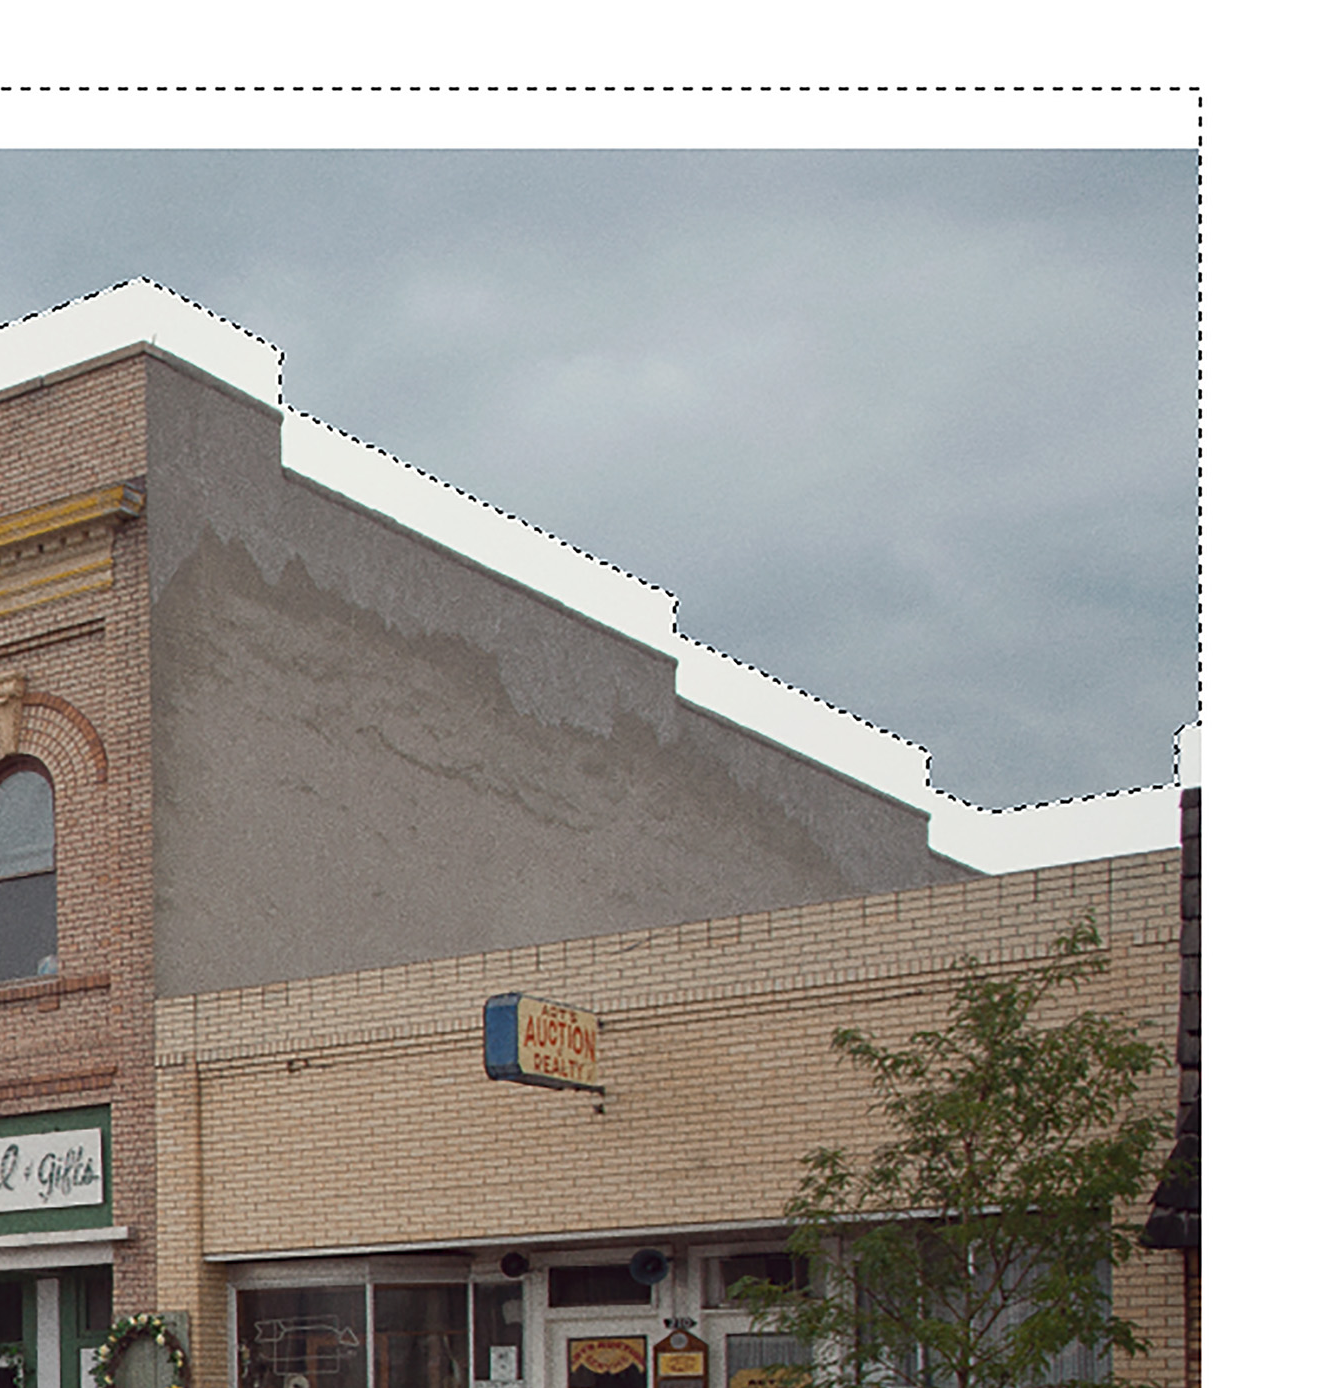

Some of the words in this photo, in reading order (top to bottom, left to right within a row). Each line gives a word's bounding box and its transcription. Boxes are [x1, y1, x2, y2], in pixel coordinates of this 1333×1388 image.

[523, 1014, 597, 1063] AUCTION
[533, 1052, 584, 1080] REALTY
[37, 1146, 101, 1203] Gifts
